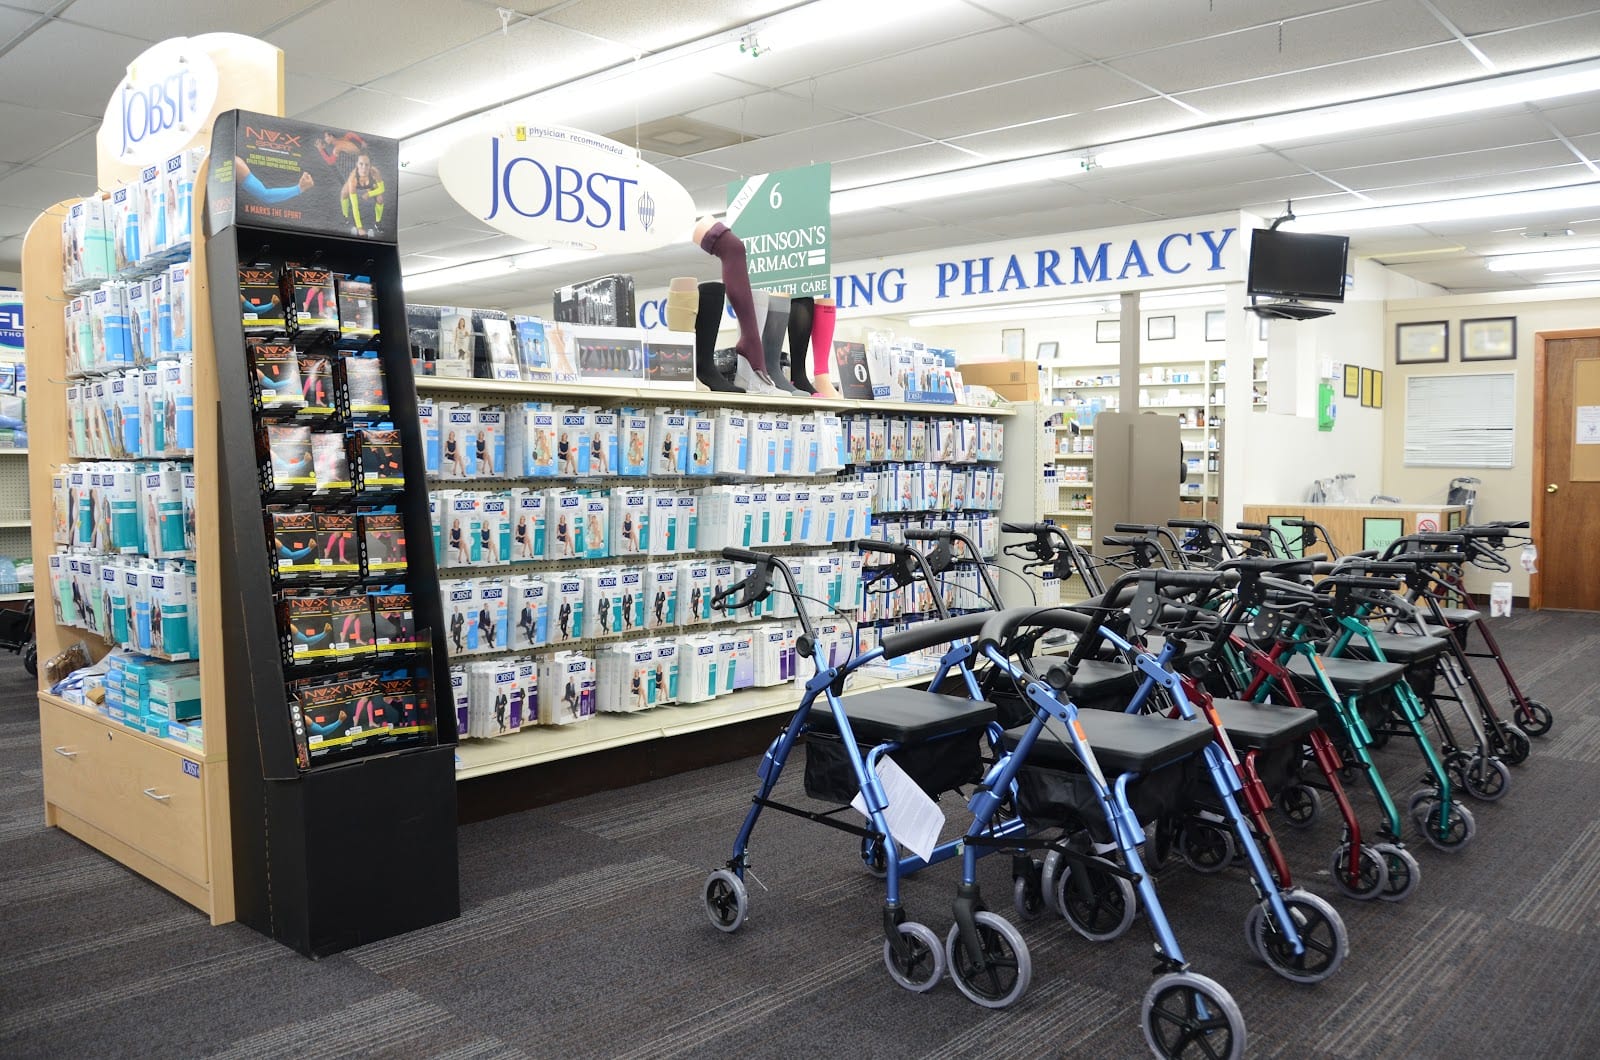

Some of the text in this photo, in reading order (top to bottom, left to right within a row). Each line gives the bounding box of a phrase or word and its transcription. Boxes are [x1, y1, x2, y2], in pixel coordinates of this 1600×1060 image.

[120, 69, 189, 157] JOBST
[529, 126, 566, 139] physician
[569, 134, 623, 155] recommended
[483, 136, 638, 232] JOBST
[769, 182, 783, 209] 6
[271, 207, 282, 218] THE
[748, 251, 808, 275] ARMACY
[936, 228, 1237, 299] PHARMACY
[801, 280, 828, 293] CARE
